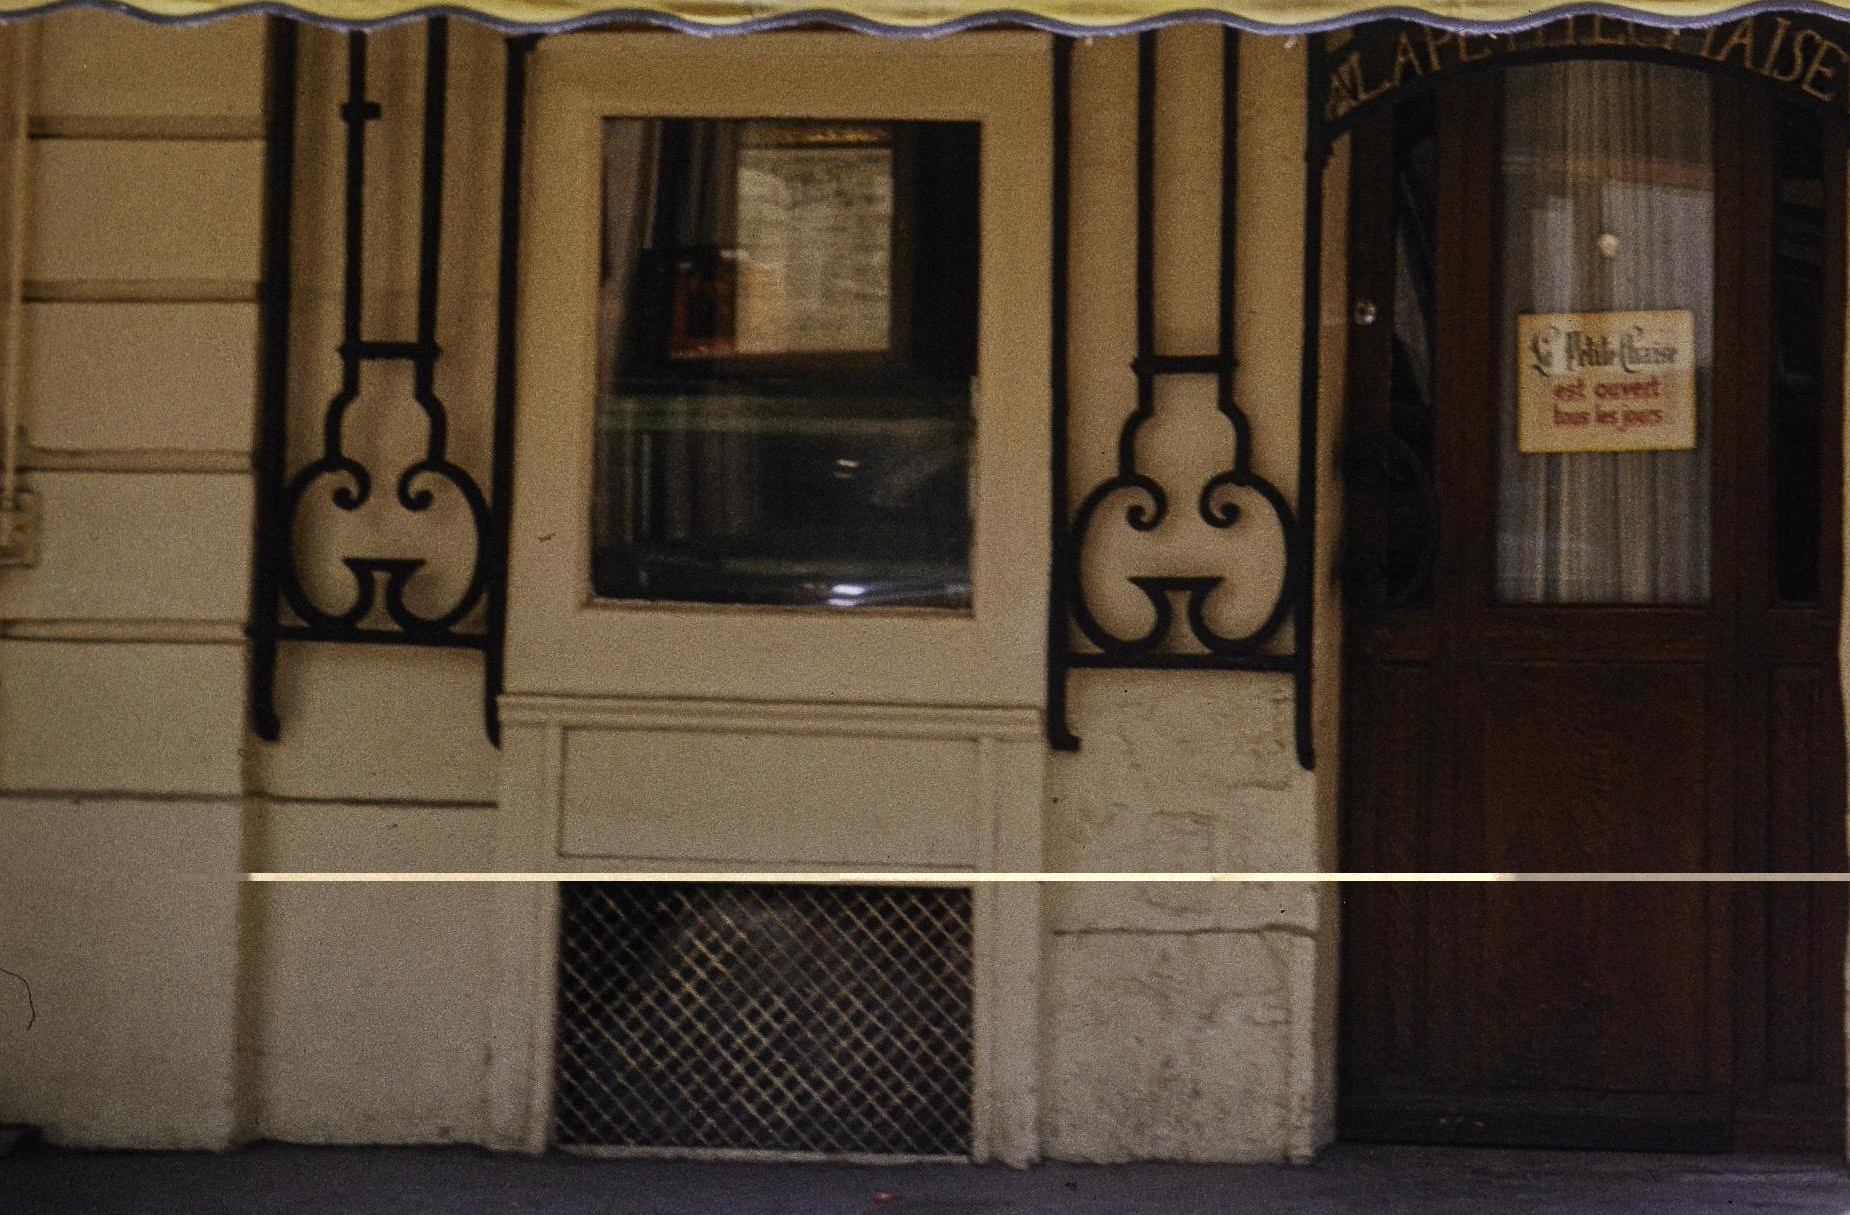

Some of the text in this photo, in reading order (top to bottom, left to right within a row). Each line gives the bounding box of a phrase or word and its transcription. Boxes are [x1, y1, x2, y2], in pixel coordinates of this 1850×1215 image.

[1553, 376, 1661, 401] est ouvert
[1553, 403, 1664, 432] tous les jours
